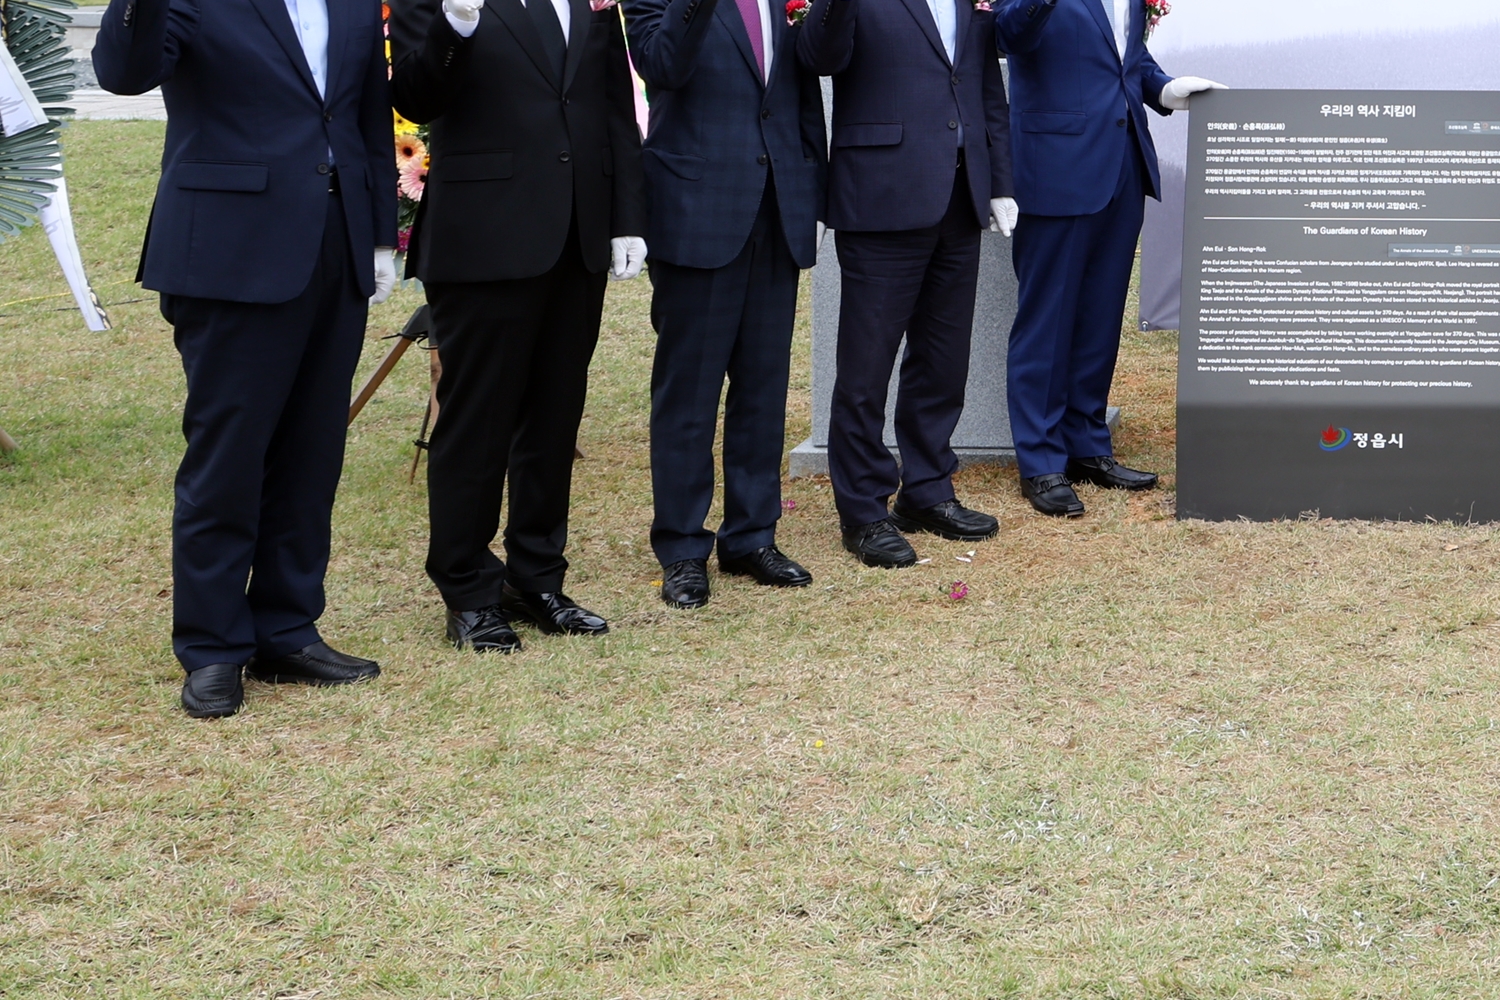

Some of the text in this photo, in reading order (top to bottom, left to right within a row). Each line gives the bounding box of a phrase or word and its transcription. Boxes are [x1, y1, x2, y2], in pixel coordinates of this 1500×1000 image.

[1320, 104, 1416, 116] 우리의 역사 지킴이
[1399, 227, 1427, 236] History
[1352, 433, 1403, 448] 정읍시
